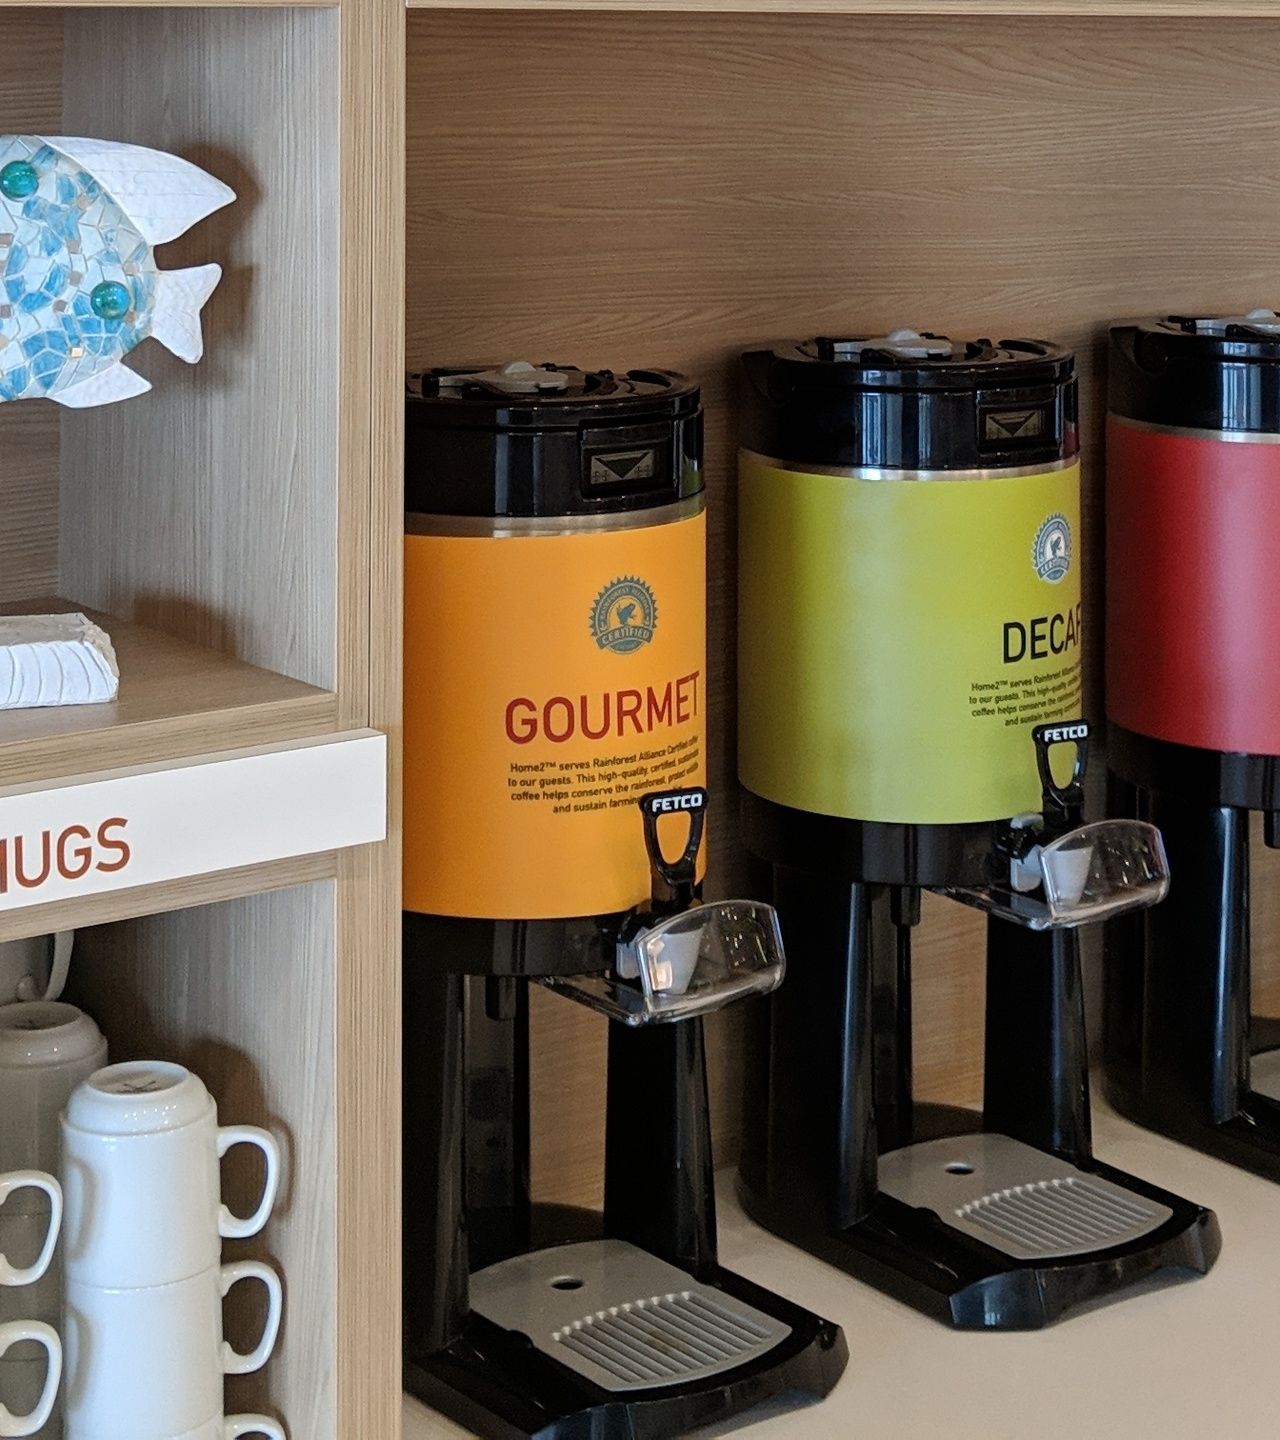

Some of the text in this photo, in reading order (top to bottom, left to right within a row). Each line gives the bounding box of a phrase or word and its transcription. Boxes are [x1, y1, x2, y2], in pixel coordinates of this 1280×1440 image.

[600, 626, 651, 646] CERTIFIED
[504, 670, 700, 745] GOURMET
[969, 696, 977, 704] to
[979, 695, 992, 704] our
[1004, 717, 1019, 727] and
[1044, 724, 1088, 742] FETCO
[559, 761, 590, 772] serves
[592, 754, 637, 768] Rainforest
[638, 749, 666, 761] Alliance
[508, 777, 518, 788] to
[519, 779, 535, 787] our
[577, 773, 596, 784] This
[510, 791, 540, 801] coffee
[542, 789, 569, 802] helps
[571, 786, 613, 798] conserve
[614, 782, 629, 793] the
[552, 803, 571, 814] and
[573, 800, 607, 812] sustain
[652, 793, 703, 813] FETCO
